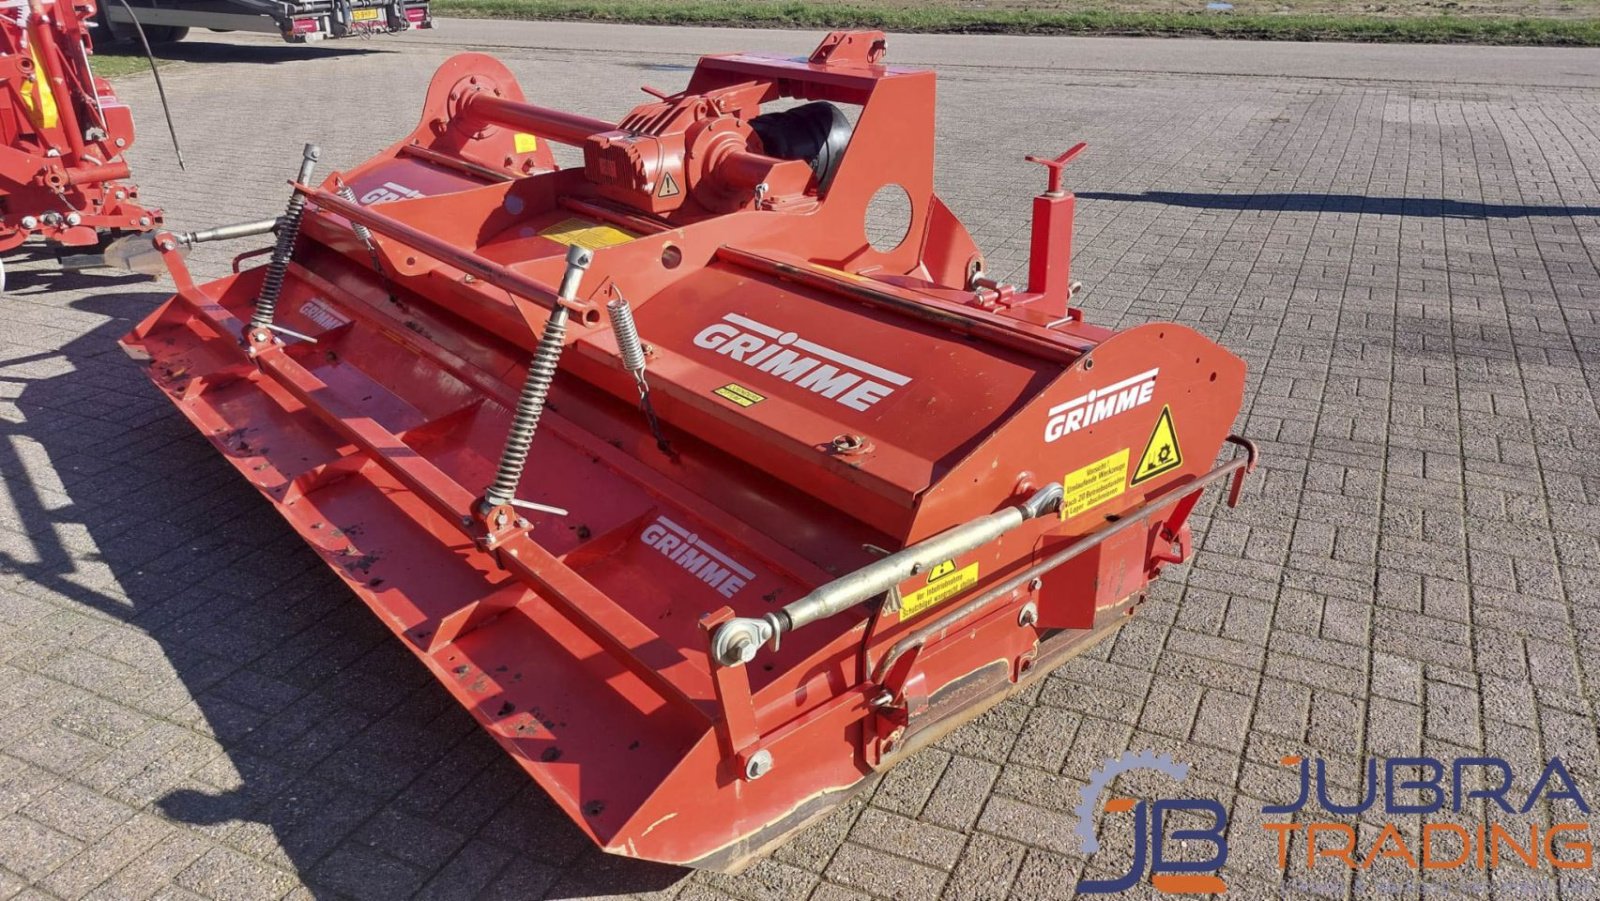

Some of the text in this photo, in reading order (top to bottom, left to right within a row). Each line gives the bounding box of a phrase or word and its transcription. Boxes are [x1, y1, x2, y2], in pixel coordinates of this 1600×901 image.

[693, 323, 894, 412] GRIMME
[1044, 380, 1156, 443] GRIMME
[641, 524, 747, 599] GRIMME
